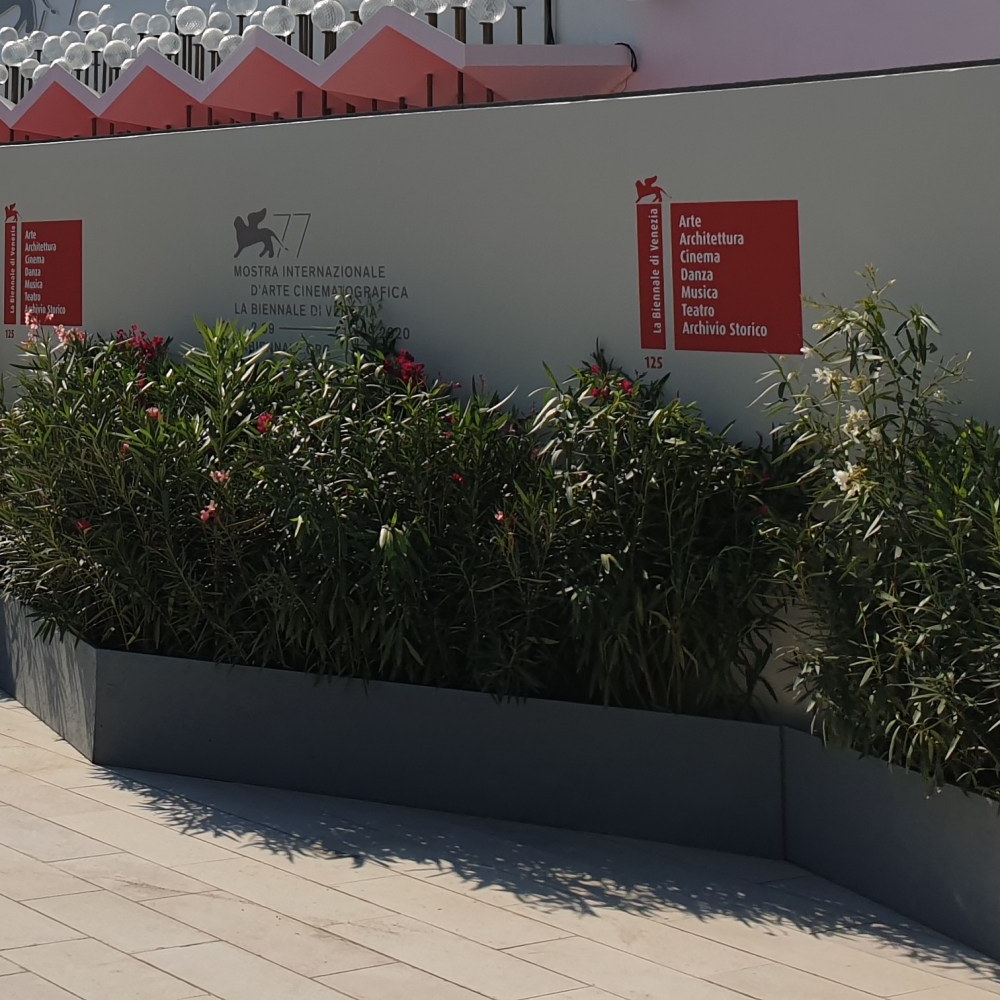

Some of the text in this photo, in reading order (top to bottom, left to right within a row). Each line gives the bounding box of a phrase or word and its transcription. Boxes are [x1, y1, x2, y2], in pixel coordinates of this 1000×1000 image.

[679, 215, 702, 228] Arte
[25, 230, 36, 239] Arte
[273, 213, 311, 258] 77
[679, 231, 745, 246] Architettura
[25, 242, 57, 252] Architettura
[25, 255, 45, 265] Cinema
[680, 250, 721, 264] Cinema
[24, 267, 41, 277] Danza
[234, 265, 386, 279] MOSTRA INTERNAZIONALE
[648, 208, 662, 334] La Biennale di Venezia
[681, 268, 714, 281] Danza
[24, 279, 43, 289] Musica
[24, 292, 41, 302] Teatro
[251, 284, 409, 299] D'ARTE CINEMATOGRAFICA
[681, 286, 719, 299] Musica
[47, 304, 66, 315] Storico
[234, 303, 247, 315] LA
[251, 303, 307, 316] BIENNALE
[310, 305, 322, 317] DI
[682, 303, 715, 317] Teatro
[682, 321, 768, 337] Archivio Storico
[644, 356, 663, 369] 125
